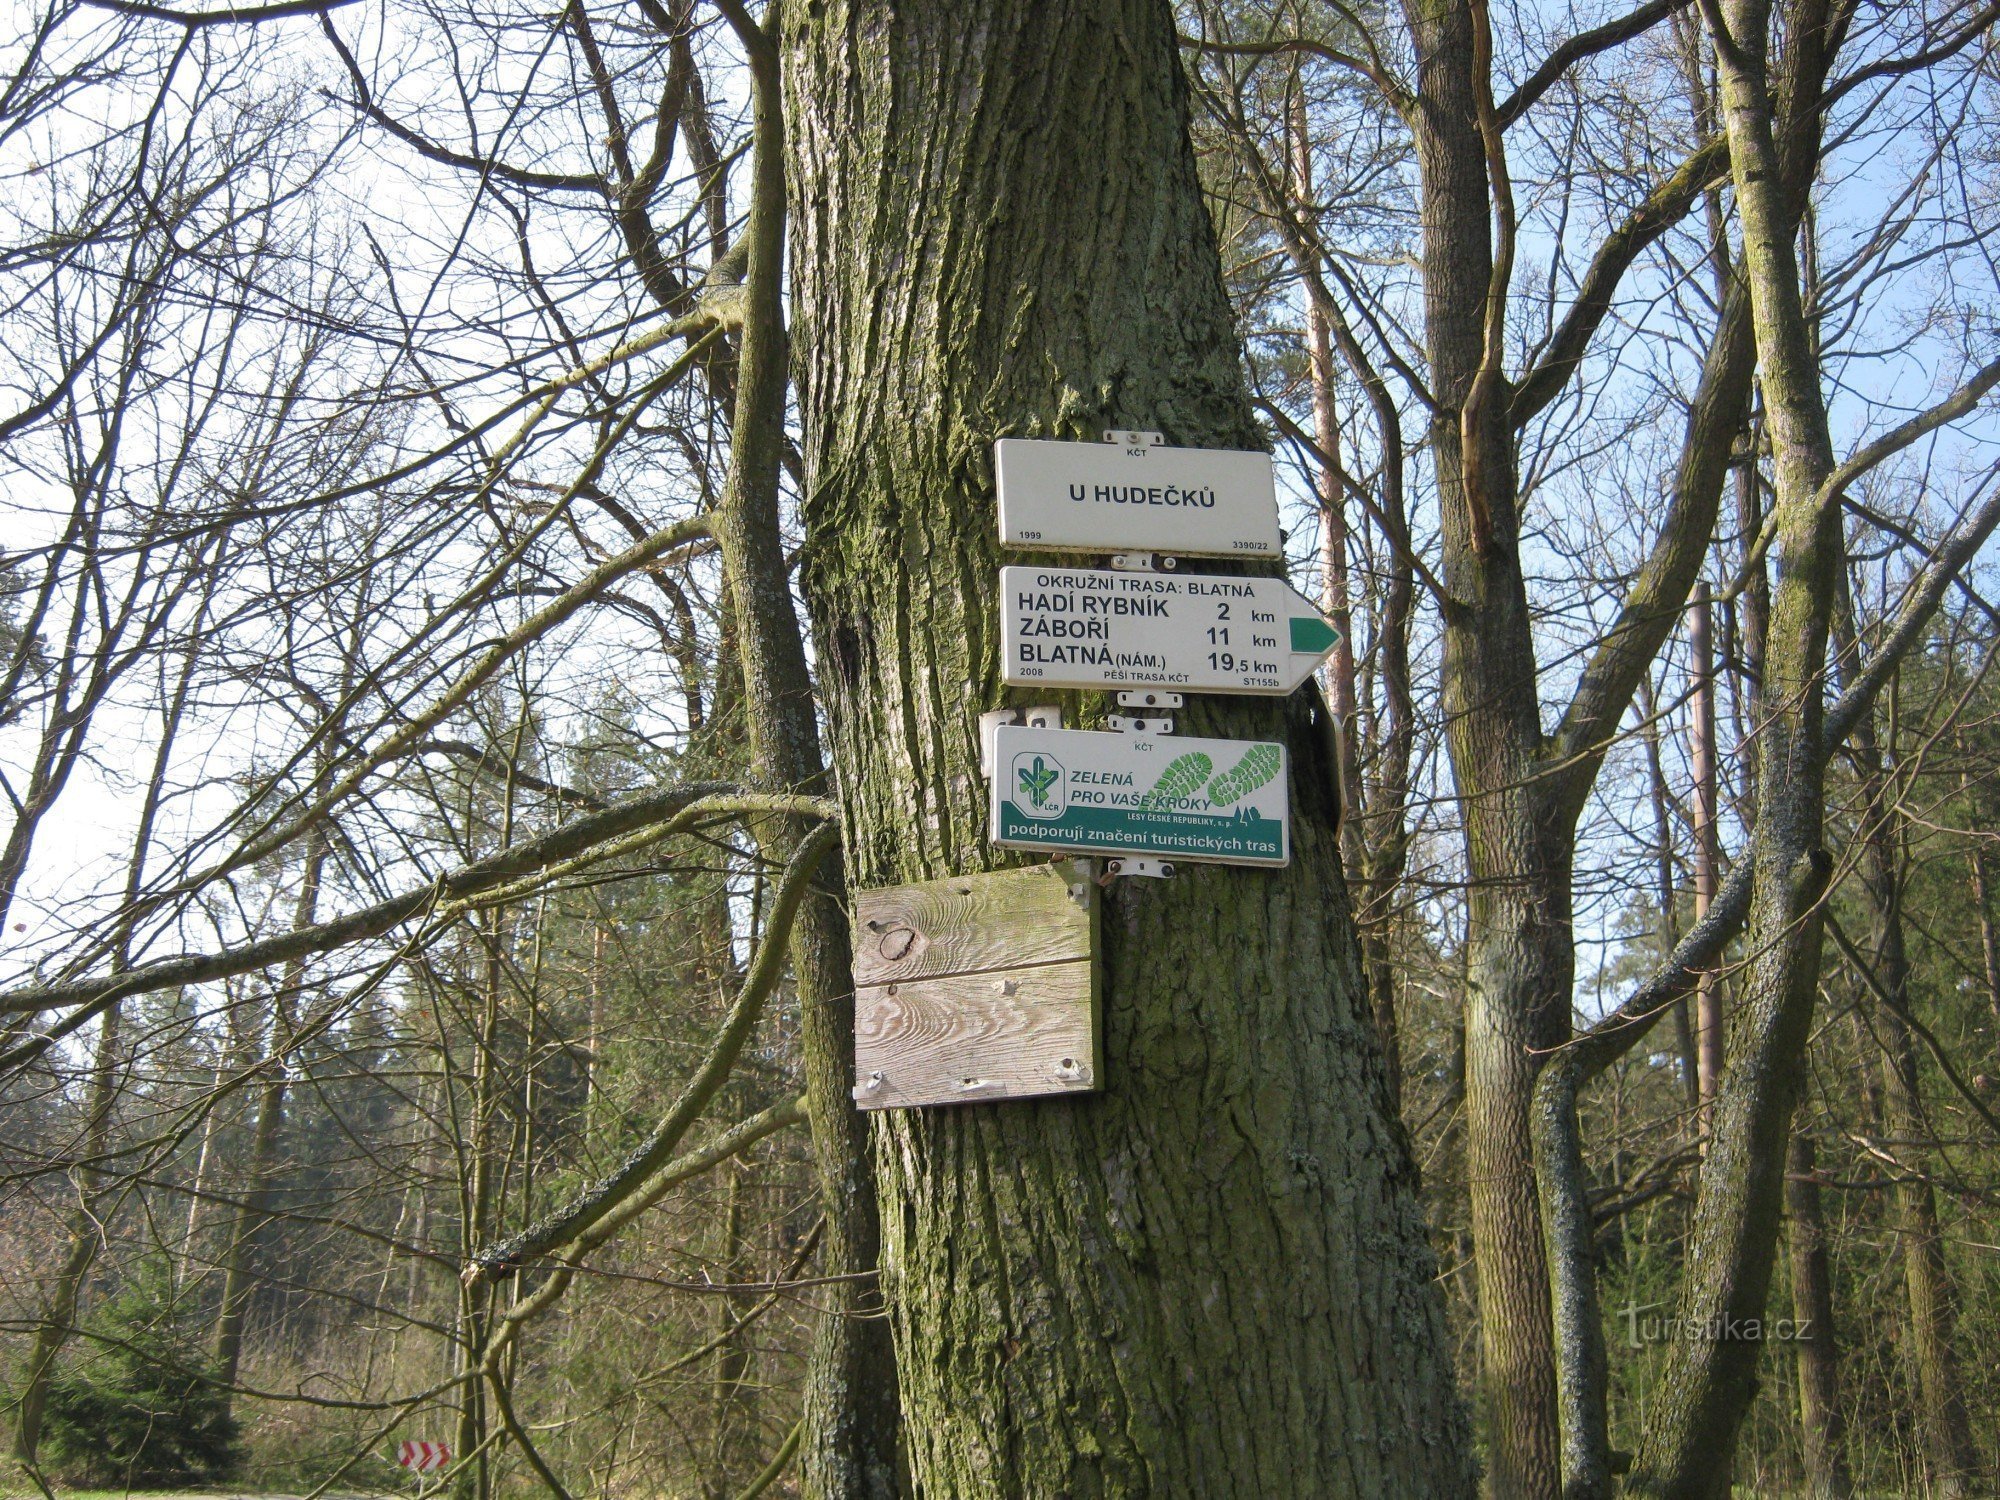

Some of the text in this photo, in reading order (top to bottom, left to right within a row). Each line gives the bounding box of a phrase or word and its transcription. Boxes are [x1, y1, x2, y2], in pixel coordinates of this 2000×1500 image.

[1126, 448, 1146, 457] KČT
[1070, 484, 1215, 508] U HUDEČKŮ
[1020, 531, 1042, 540] 1999
[1233, 541, 1268, 550] 3390/22
[1037, 574, 1255, 598] OKRUŽNÍ TRASA: BLATNÁ
[1018, 591, 1275, 623] HADÍ RYBNÍK 2 km
[1020, 614, 1276, 648] ZÁBOŘÍ 11 km
[1208, 652, 1249, 674] 19,5
[1254, 660, 1278, 674] km
[1020, 668, 1280, 687] 2008 PĚŠÍ TRASA KČT ST155b
[1070, 771, 1134, 786] ZELENÁ
[1071, 790, 1212, 811] PRO VAŠE KROKY
[1128, 813, 1146, 821] LESY
[1148, 812, 1171, 822] ČESKÉ
[1009, 824, 1276, 852] podporují značení turistických tras
